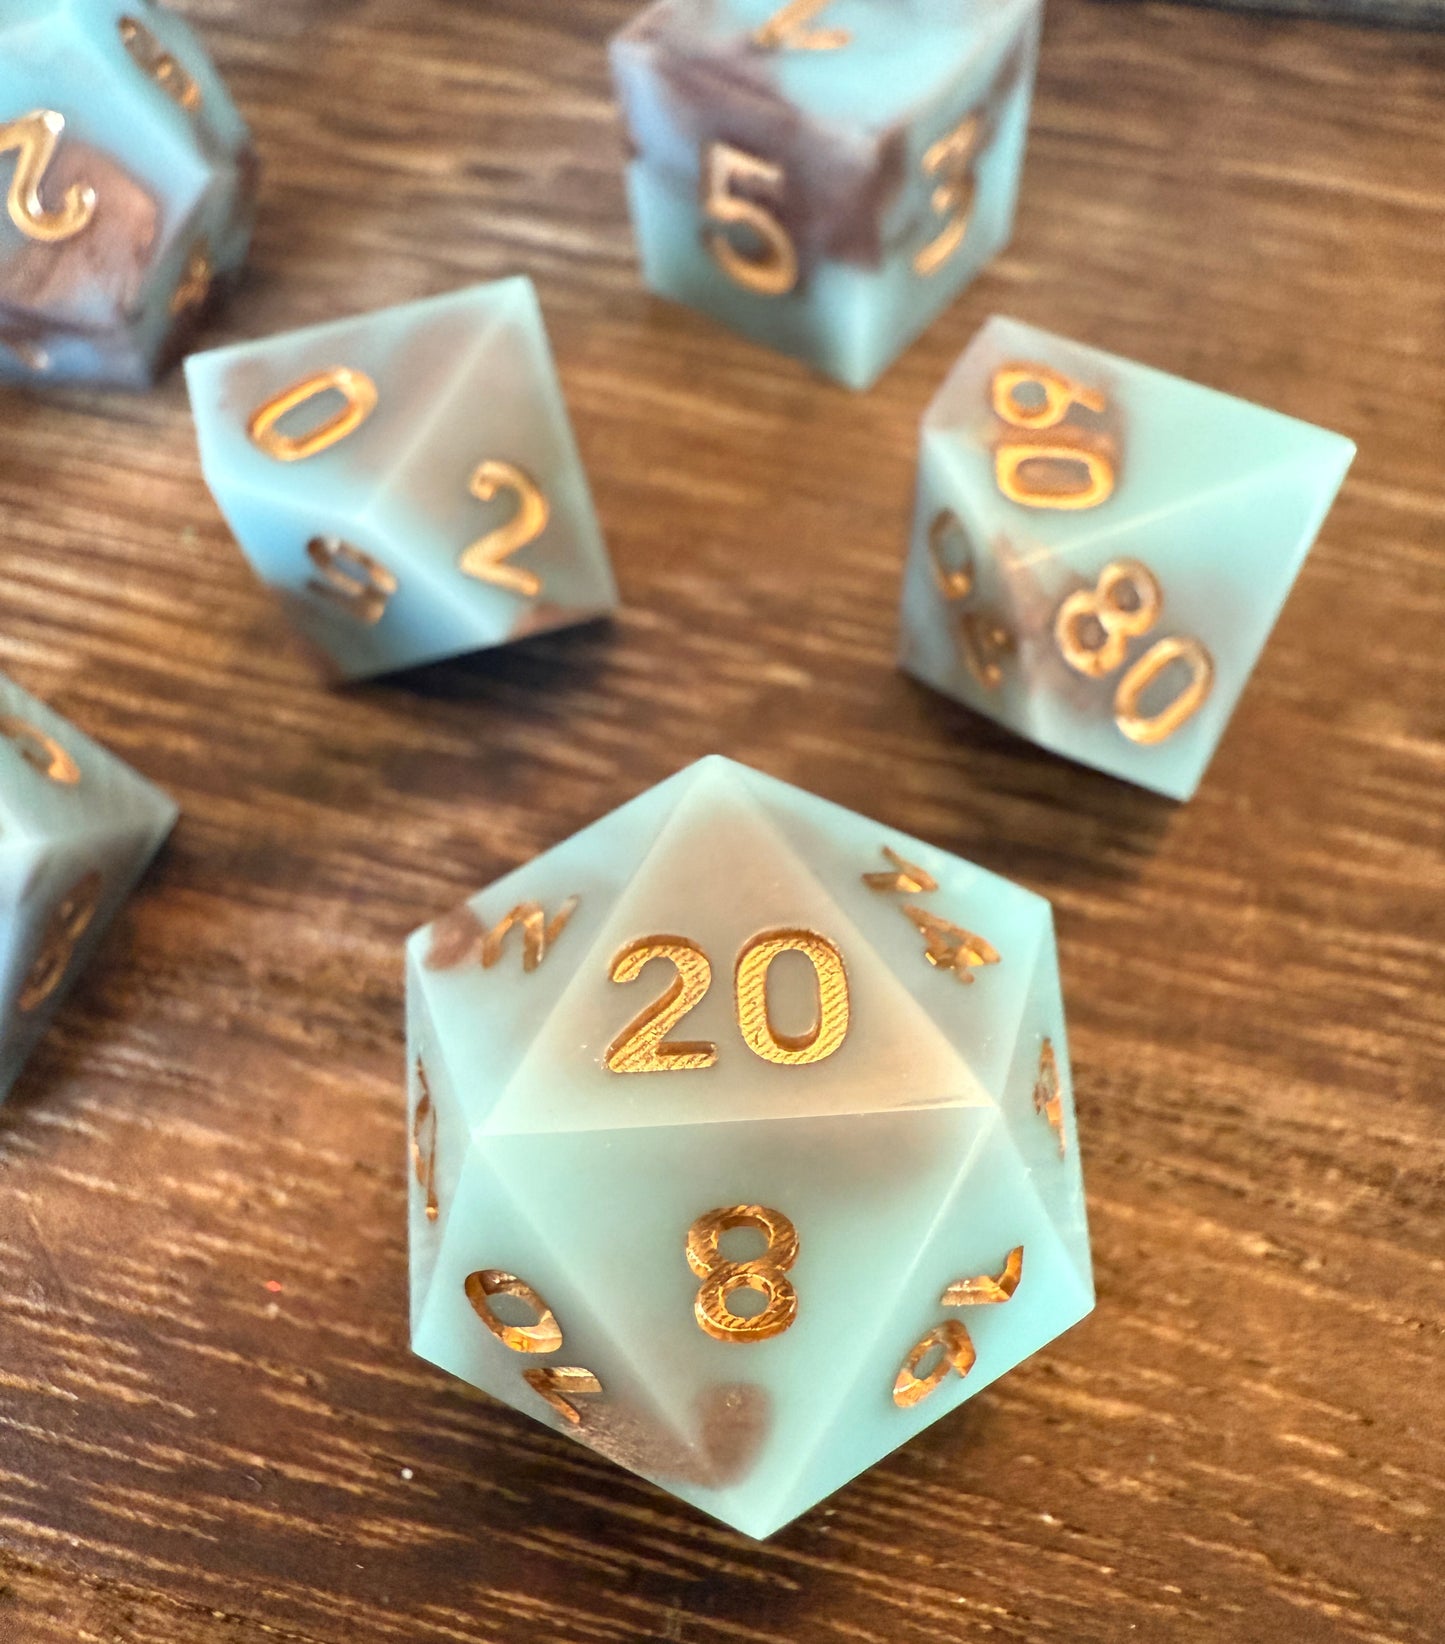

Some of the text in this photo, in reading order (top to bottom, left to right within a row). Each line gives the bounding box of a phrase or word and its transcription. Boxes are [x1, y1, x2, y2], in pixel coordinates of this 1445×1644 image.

[702, 142, 798, 295] 5
[247, 366, 379, 461] 0
[460, 460, 550, 596] 2
[1054, 557, 1215, 745] 80
[604, 927, 849, 1073] 20
[685, 1204, 800, 1343] 8
